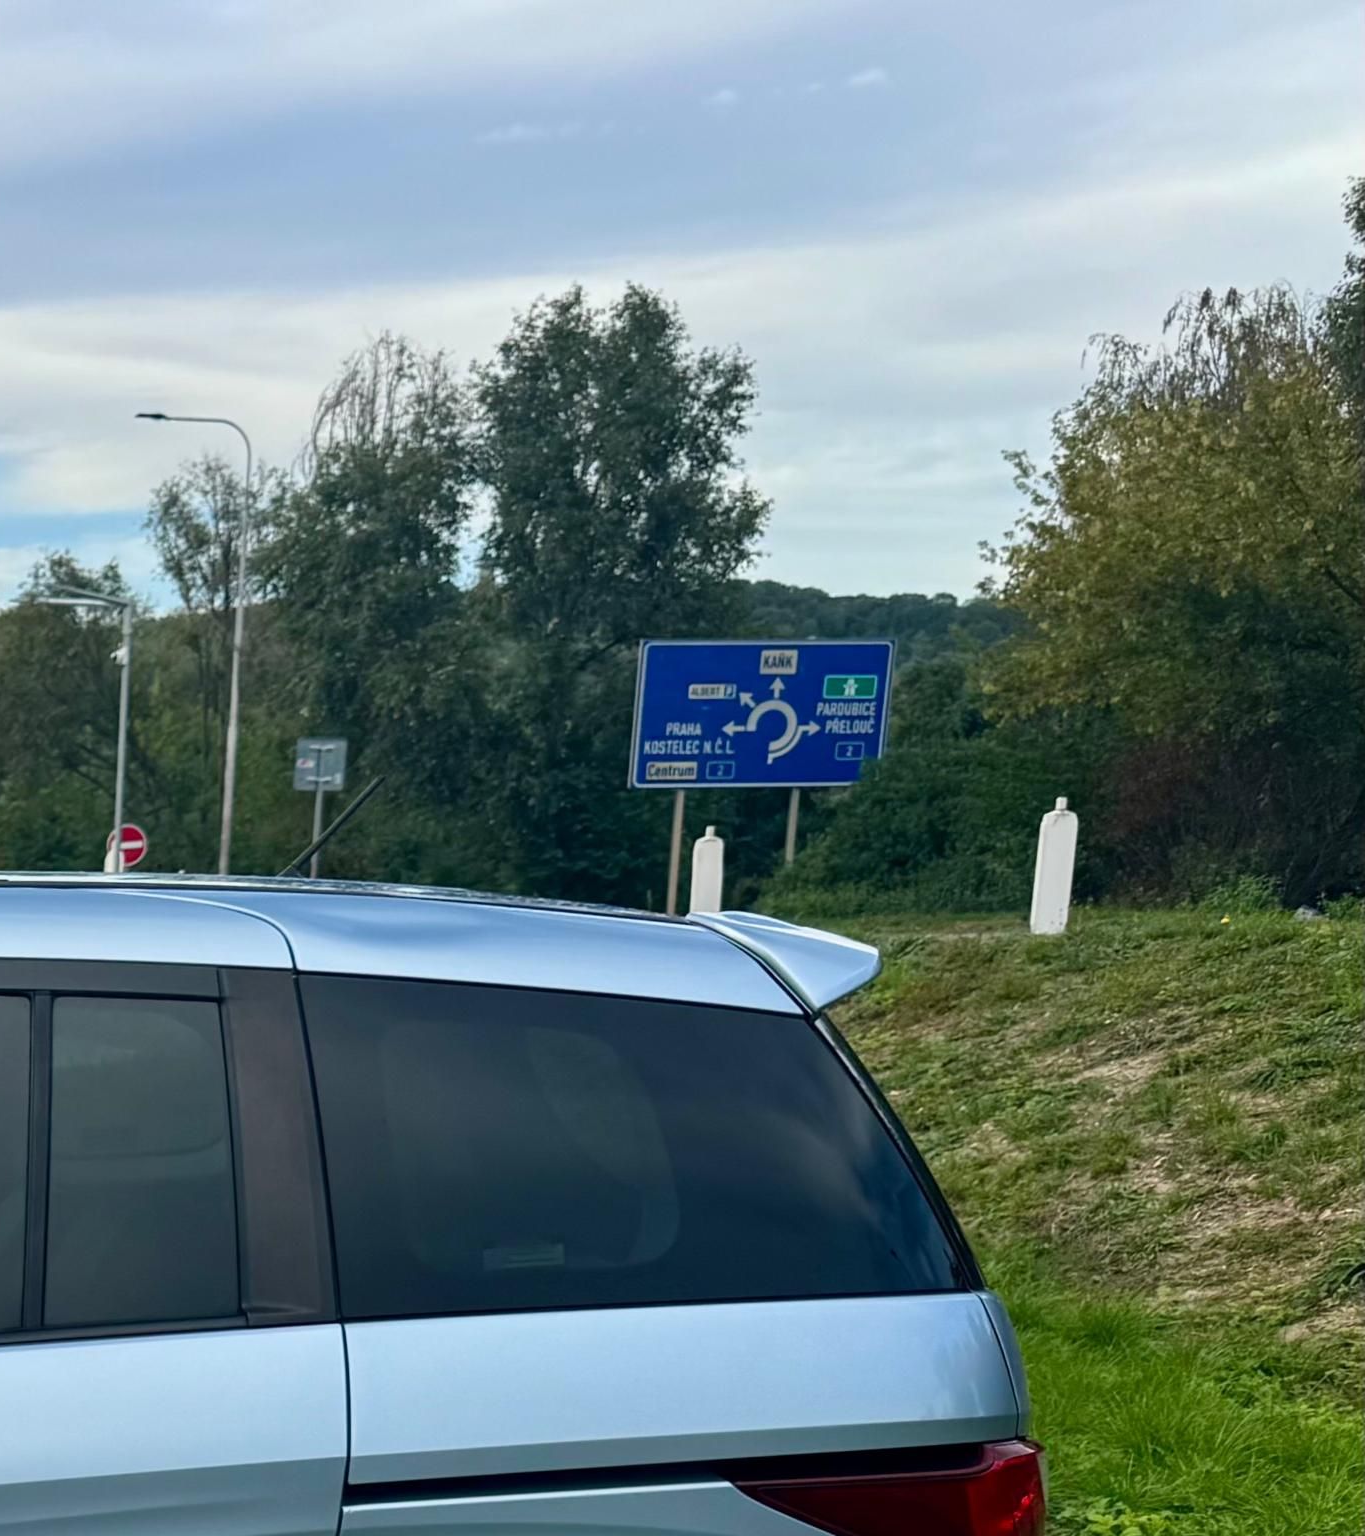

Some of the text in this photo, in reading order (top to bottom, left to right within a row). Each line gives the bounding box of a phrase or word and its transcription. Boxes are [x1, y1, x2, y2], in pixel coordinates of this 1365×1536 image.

[816, 702, 877, 716] PARDUBICE
[665, 722, 702, 736] PRAHA
[825, 717, 876, 734] PŘELOUČ
[643, 740, 700, 755] KOSTELEC
[845, 746, 854, 757] 2
[647, 763, 696, 778] Centrum
[716, 765, 724, 776] 2
